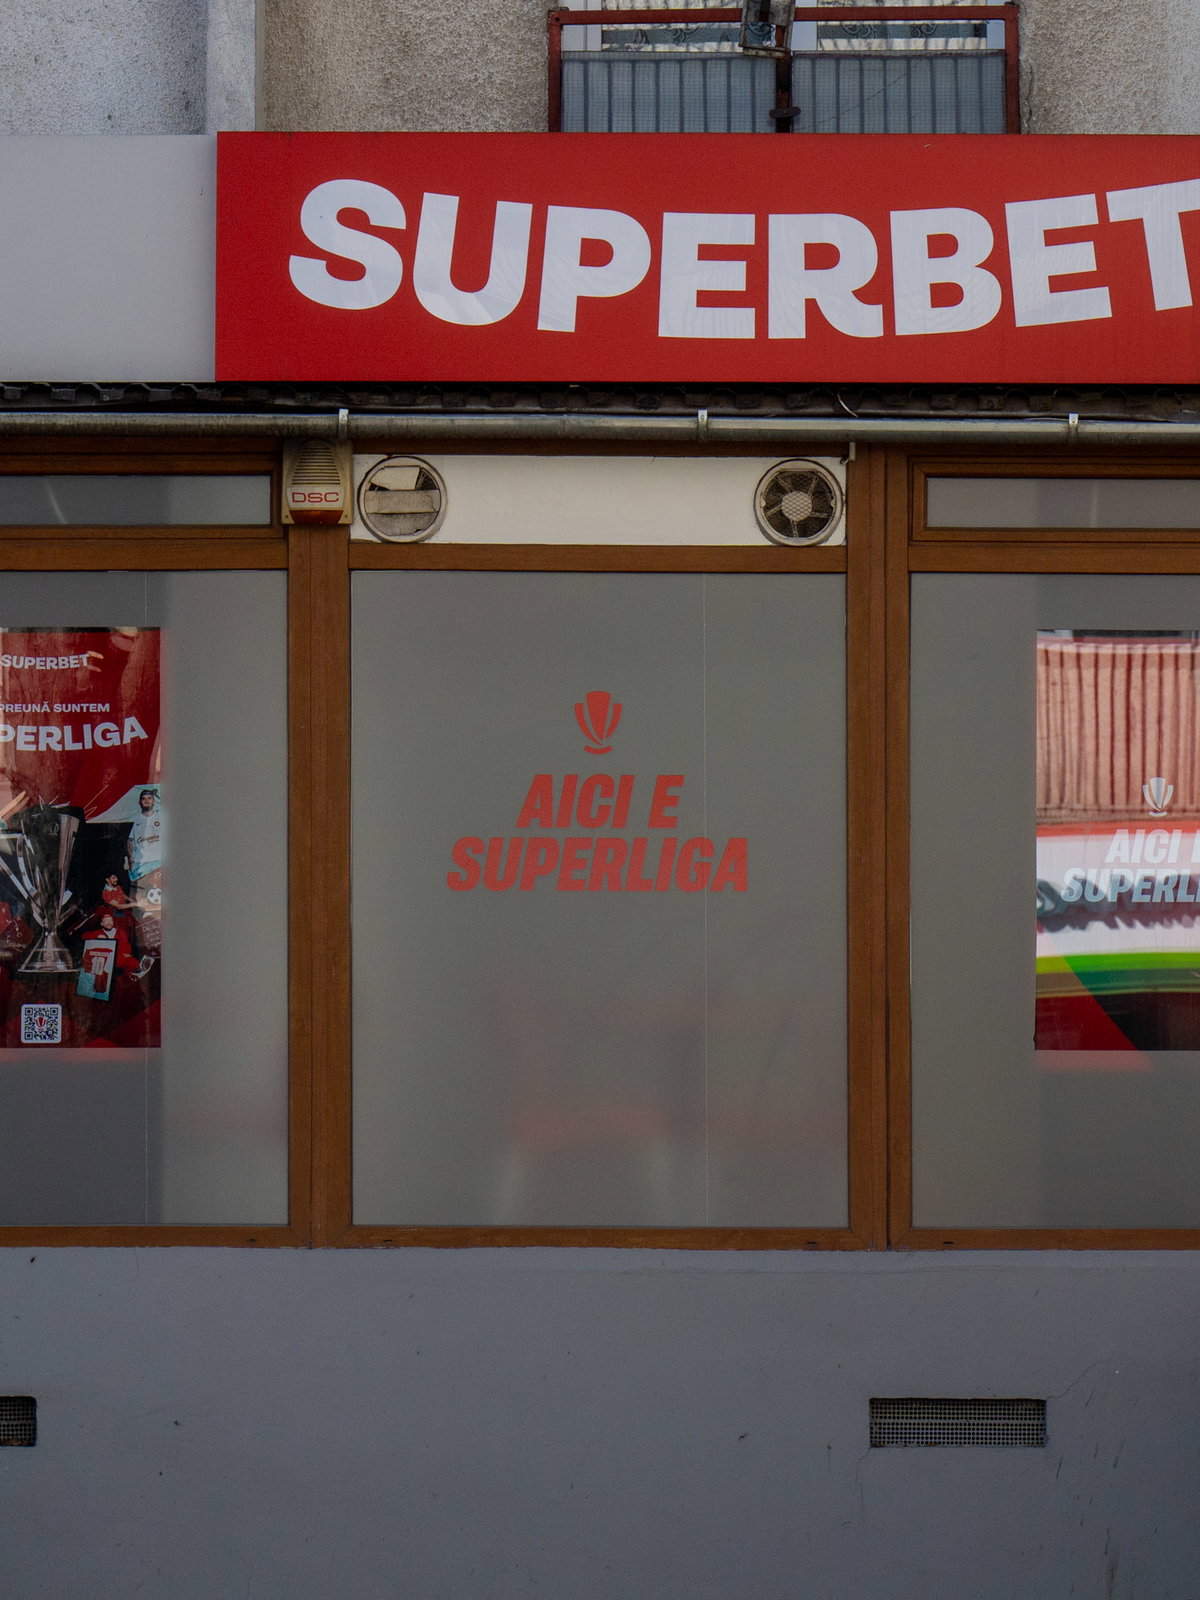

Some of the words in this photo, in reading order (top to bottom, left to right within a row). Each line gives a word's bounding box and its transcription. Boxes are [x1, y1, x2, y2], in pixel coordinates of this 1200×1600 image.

[292, 492, 339, 503] DSC
[0, 653, 90, 669] SUPERBET
[54, 703, 110, 712] SUNTEM
[0, 716, 149, 751] PERLIGA
[515, 774, 635, 828] AICI
[648, 774, 685, 828] E
[1105, 829, 1182, 863] AICI
[447, 836, 748, 892] SUPERLIGA
